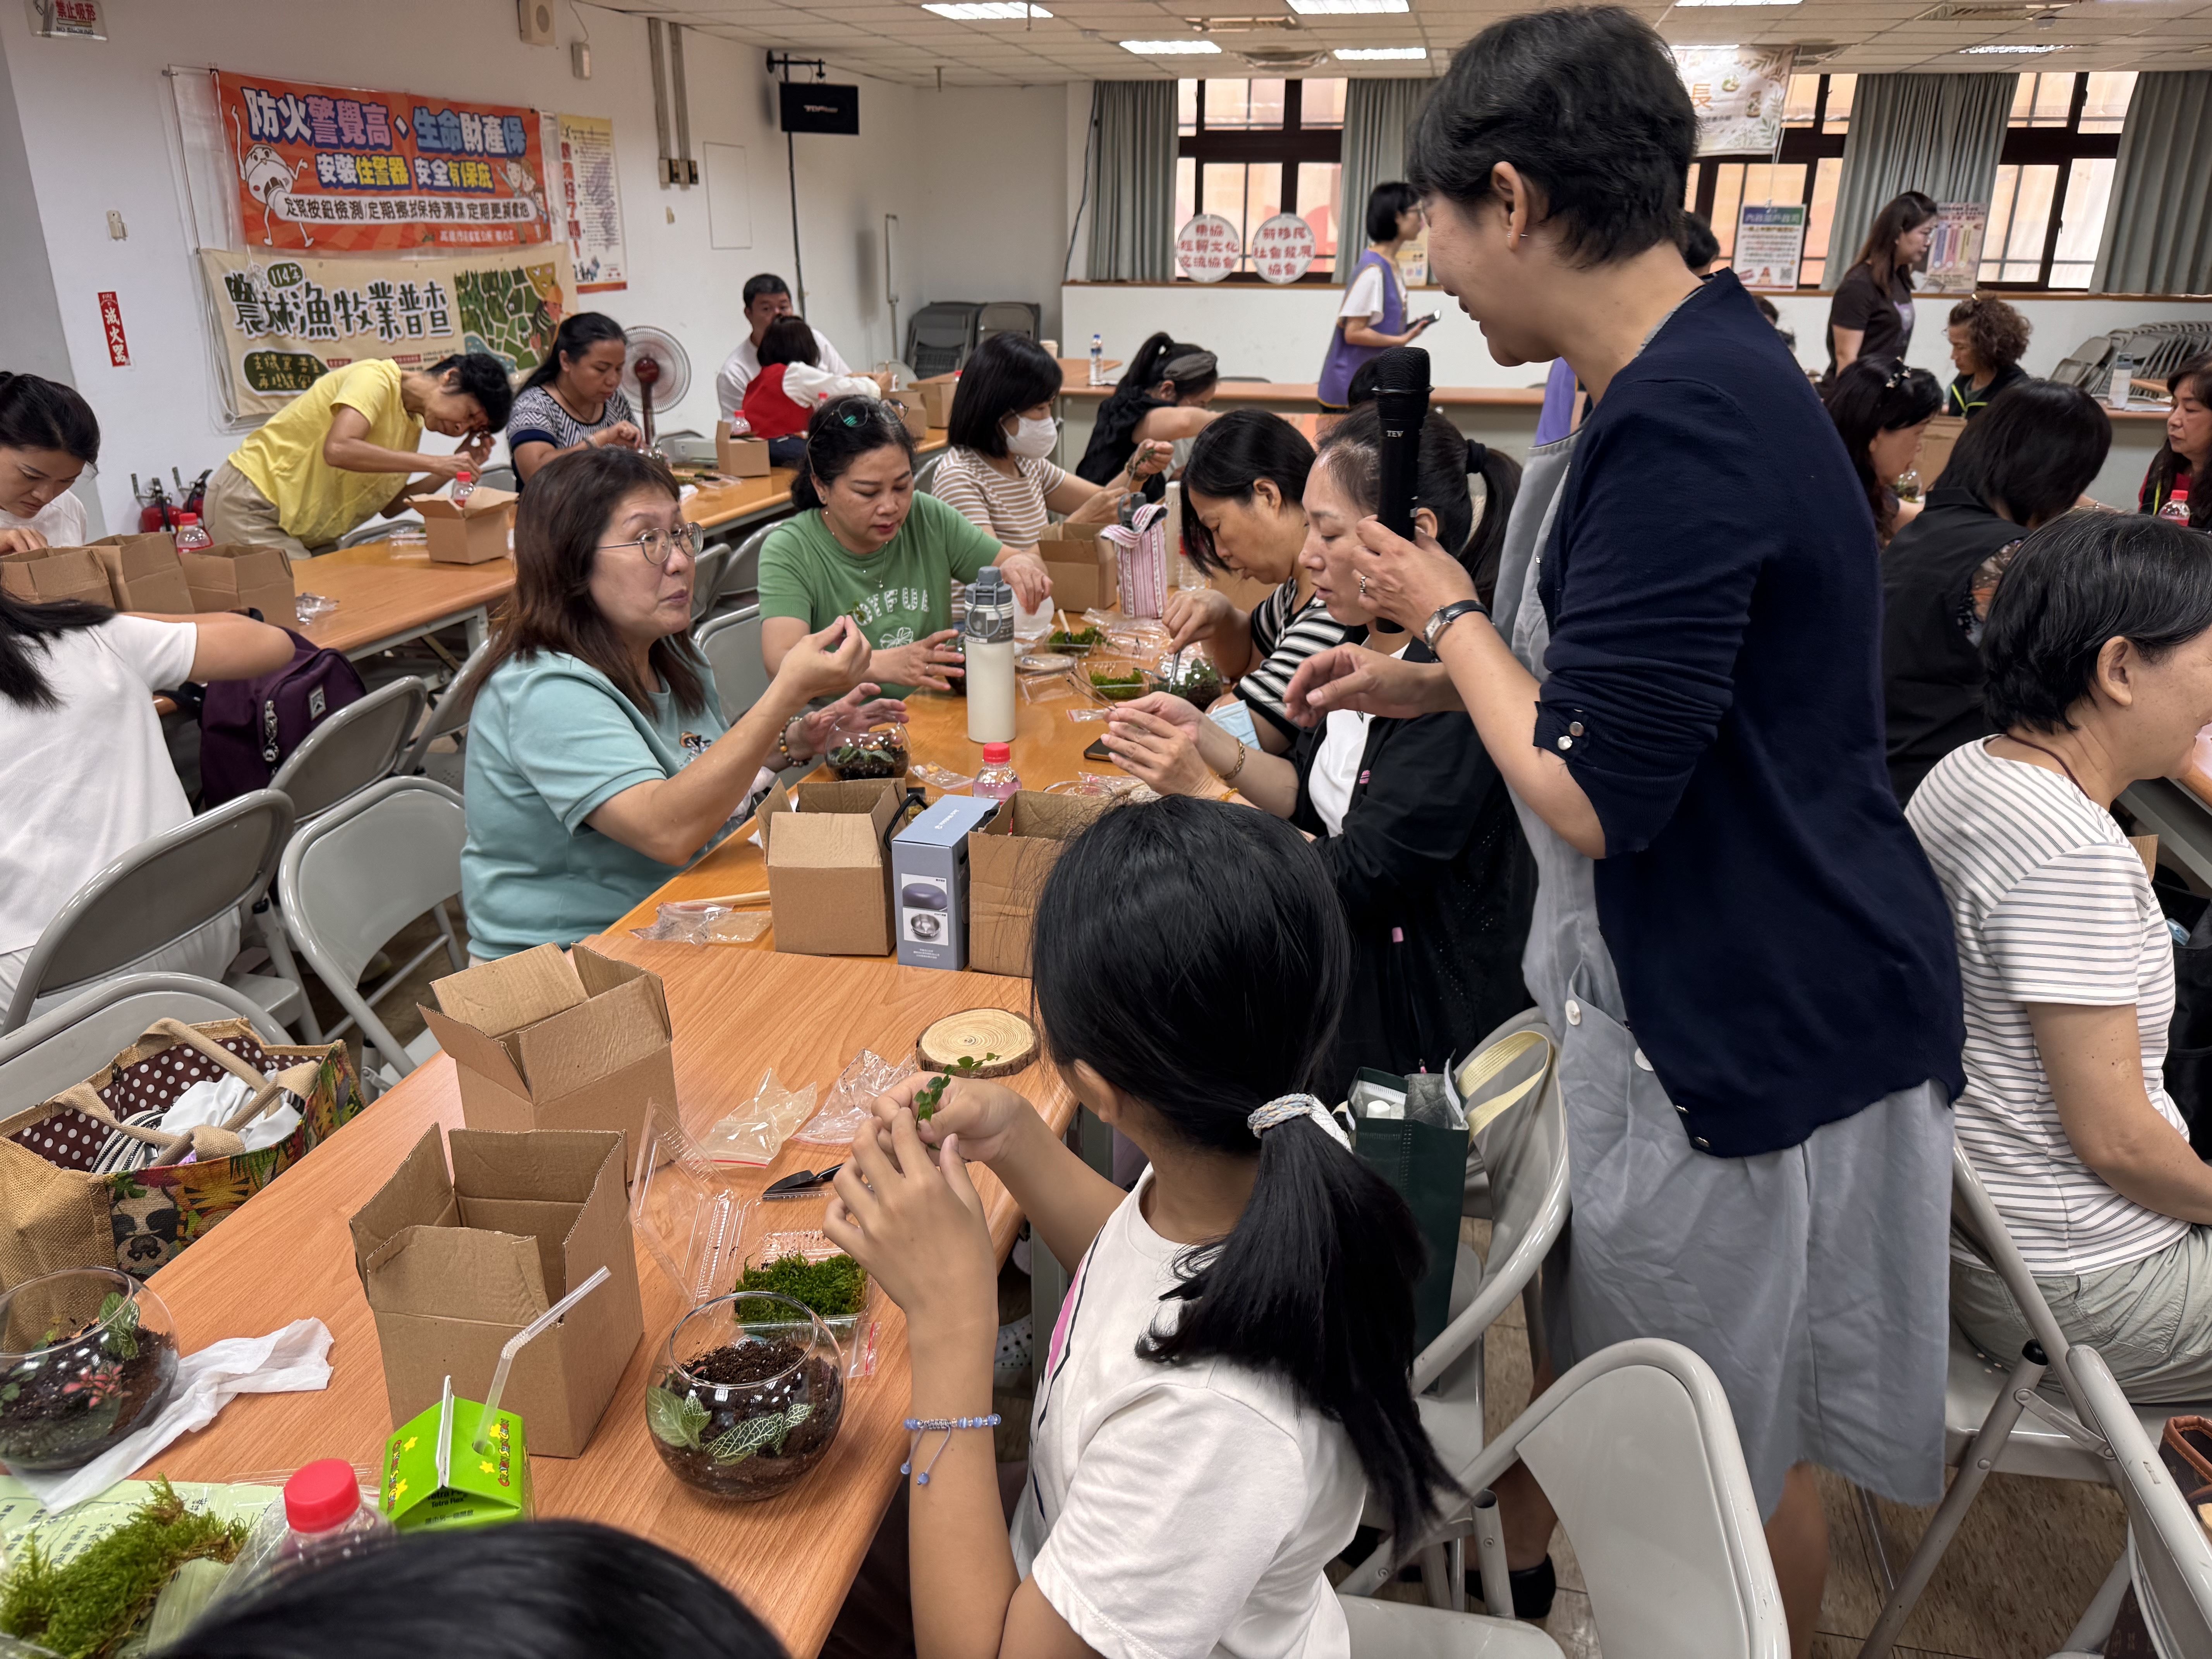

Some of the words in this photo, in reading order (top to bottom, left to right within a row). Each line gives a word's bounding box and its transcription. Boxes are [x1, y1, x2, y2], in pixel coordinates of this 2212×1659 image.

[316, 154, 410, 186] 安裝住警器
[1262, 227, 1307, 240] 新移民
[1180, 256, 1235, 269] 交流協會
[1254, 245, 1313, 259] 社會發展
[271, 265, 301, 286] 114年
[1268, 263, 1297, 276] 協會
[225, 272, 452, 340] 農林漁牧業普查
[105, 307, 126, 362] 滅火器
[853, 587, 929, 626] OYFUL
